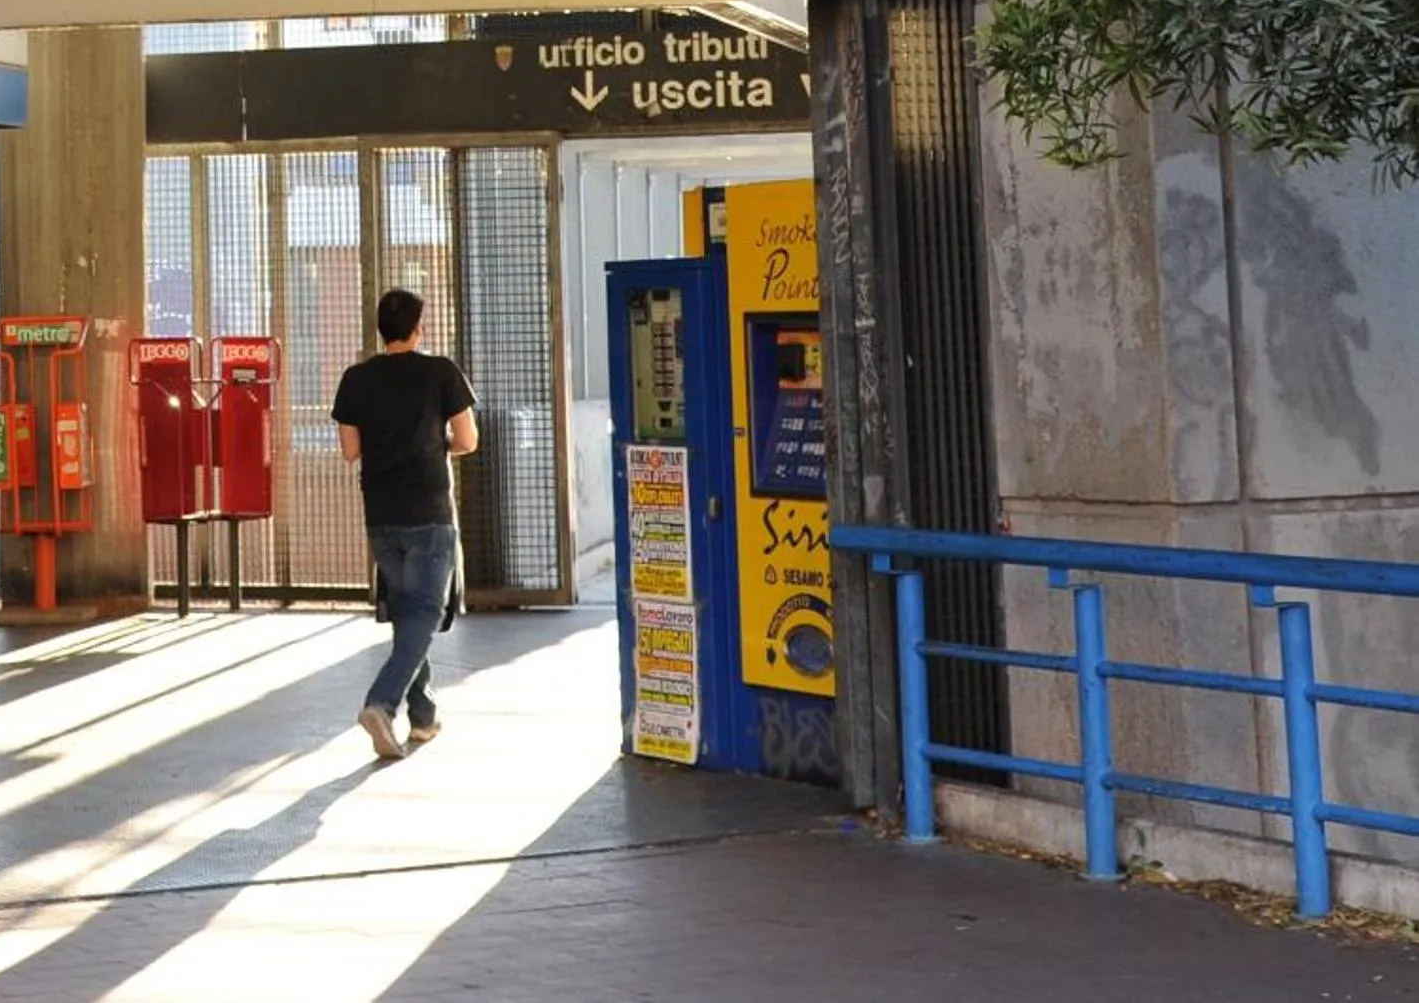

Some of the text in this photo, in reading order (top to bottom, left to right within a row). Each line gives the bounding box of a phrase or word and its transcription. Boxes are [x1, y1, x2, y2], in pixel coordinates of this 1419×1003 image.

[538, 32, 768, 68] ufficio tributi
[633, 70, 773, 108] uscita
[783, 567, 824, 588] SESAMO
